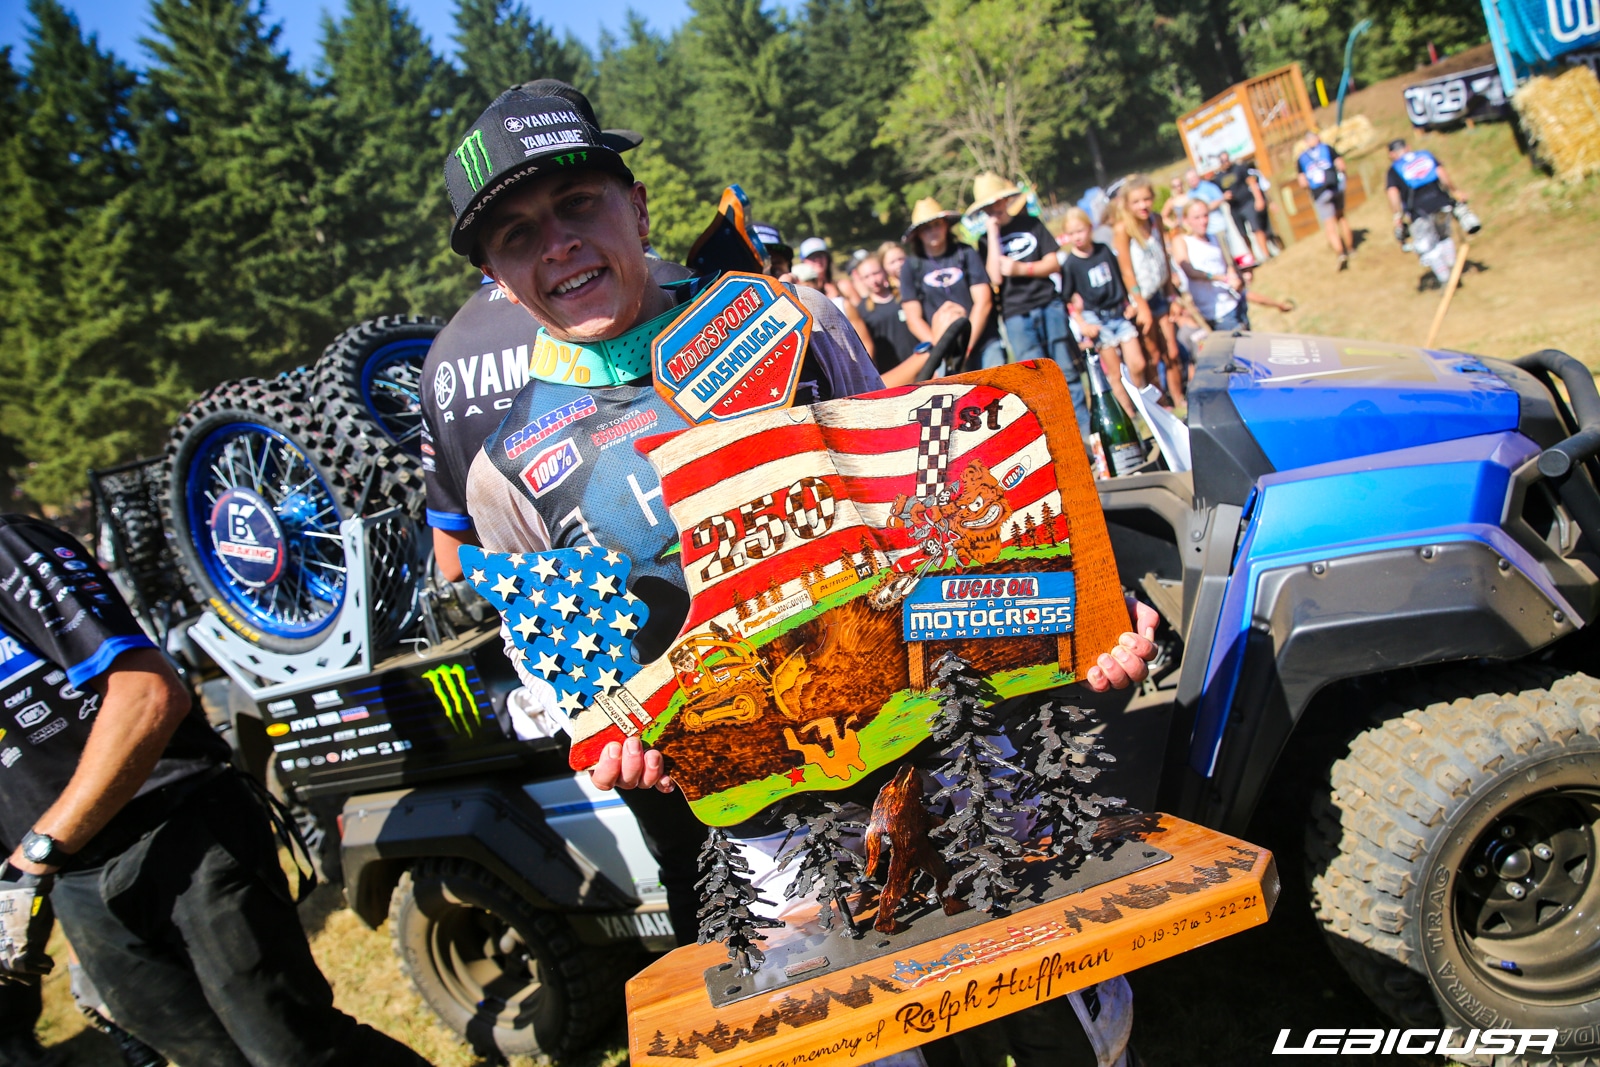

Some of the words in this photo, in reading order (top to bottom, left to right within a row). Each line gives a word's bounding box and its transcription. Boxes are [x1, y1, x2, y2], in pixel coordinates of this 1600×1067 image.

[520, 111, 579, 128] YAMAHA
[520, 129, 583, 149] YAMALUBE
[473, 166, 539, 211] YAMAHA
[690, 315, 787, 403] WASHOUGAL
[722, 343, 791, 408] NATIONAL
[504, 395, 596, 450] PARTS
[590, 409, 658, 447] ESCONDIDO
[608, 409, 641, 426] TOYOTA
[507, 405, 598, 460] UNLIMITED
[600, 435, 627, 451] ACTION
[630, 421, 658, 437] SPORTS
[531, 444, 573, 490] 100%
[1003, 464, 1025, 489] 100%
[692, 476, 835, 583] 250
[858, 565, 872, 578] CAT
[946, 579, 1005, 599] LUCAS
[1007, 578, 1034, 597] OIL
[775, 592, 810, 613] VANCOUVER
[970, 600, 1013, 608] PRO
[910, 606, 1072, 631] MOTOCROSS
[909, 624, 1072, 640] CHAMPIONSHIP
[1190, 919, 1201, 930] to
[791, 1037, 862, 1065] memory
[866, 1019, 886, 1048] of
[895, 979, 982, 1034] Ralph
[988, 947, 1114, 1008] Huffman
